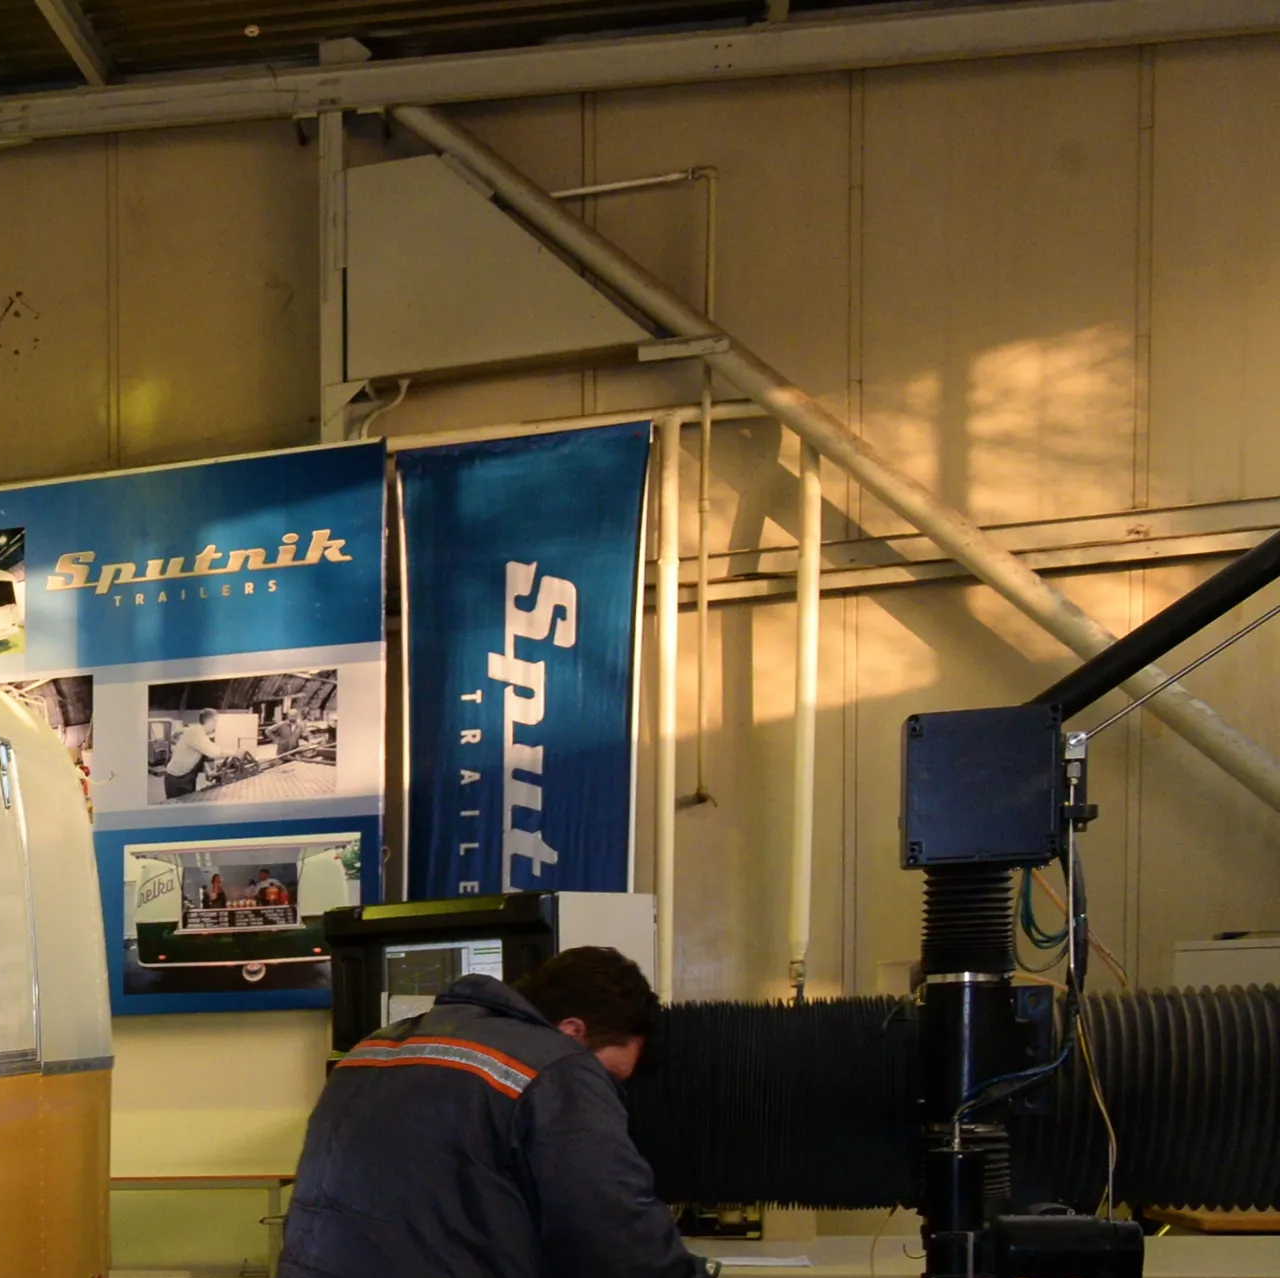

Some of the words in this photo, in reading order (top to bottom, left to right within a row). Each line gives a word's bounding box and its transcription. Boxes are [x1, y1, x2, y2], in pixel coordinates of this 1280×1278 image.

[46, 528, 353, 595] Sputnik
[113, 579, 278, 607] TRAILERS
[459, 689, 483, 895] TRAILE
[487, 560, 578, 894] Sput
